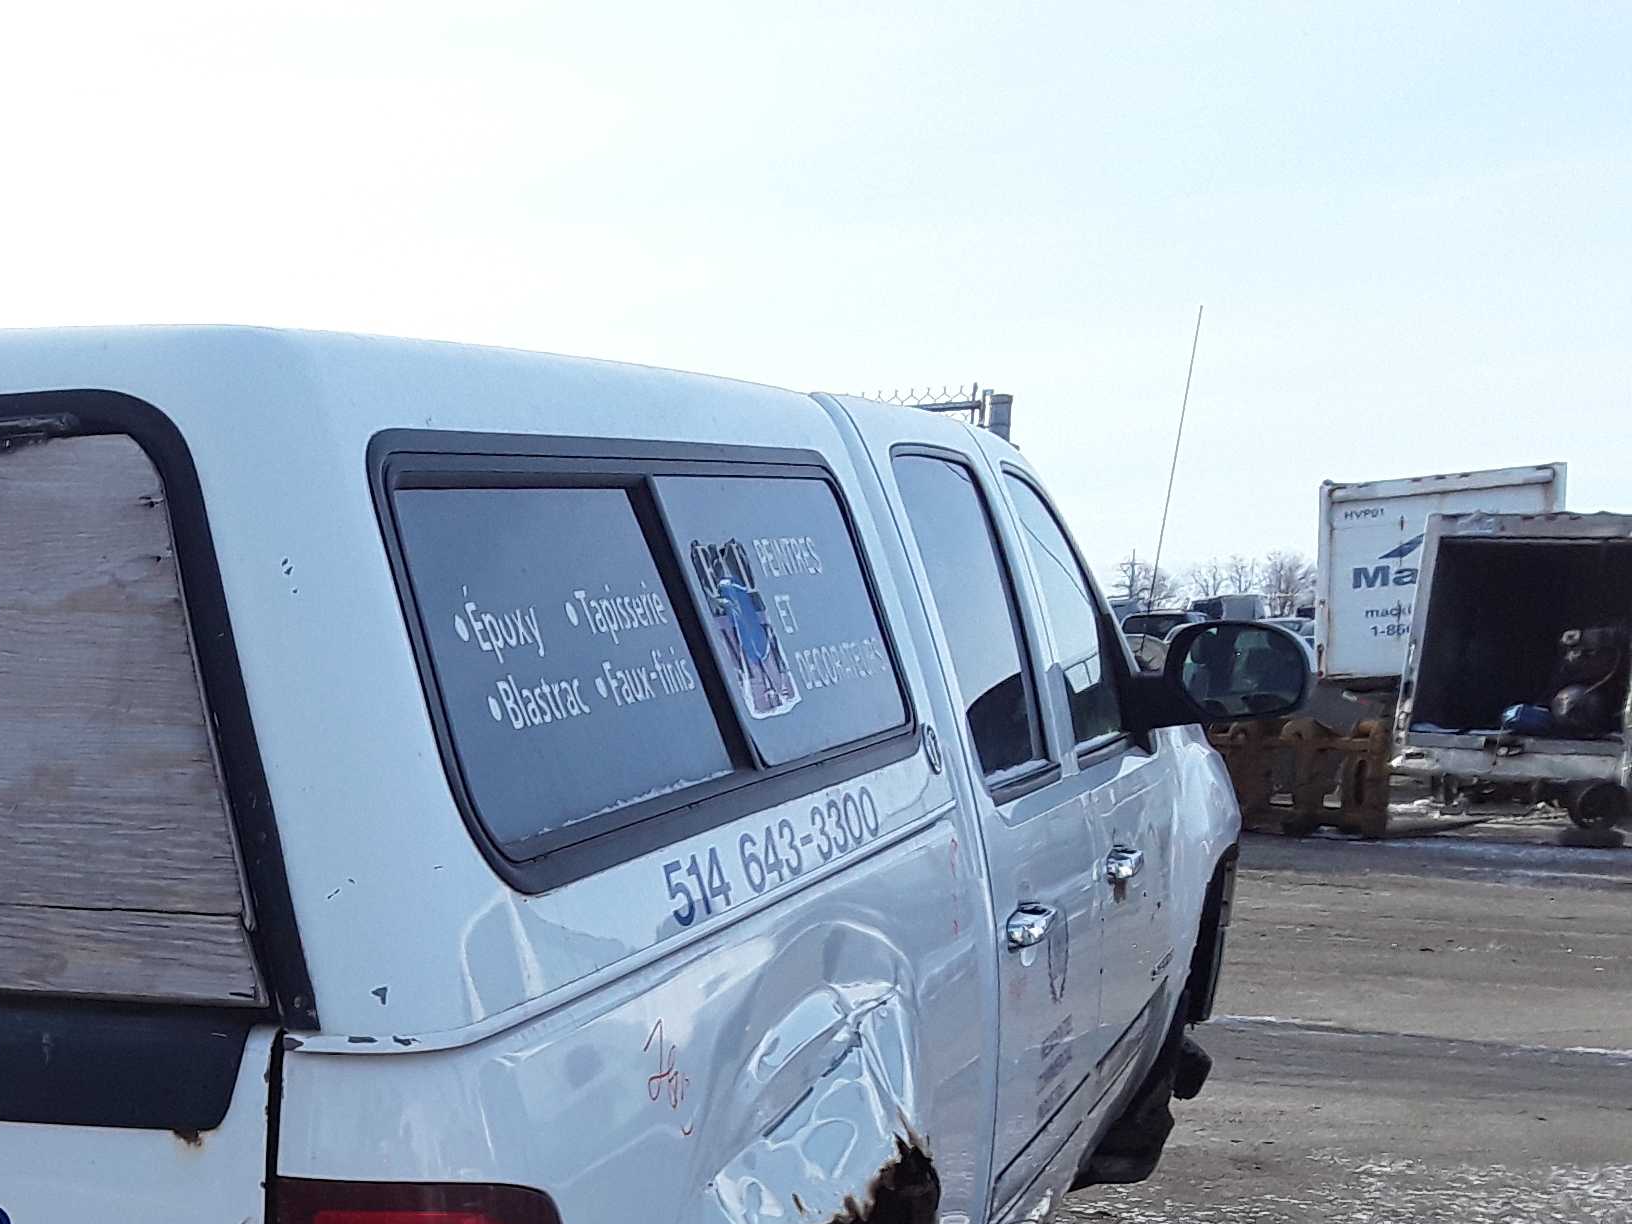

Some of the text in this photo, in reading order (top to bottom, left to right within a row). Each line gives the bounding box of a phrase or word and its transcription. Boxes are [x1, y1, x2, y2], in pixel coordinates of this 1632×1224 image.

[753, 537, 822, 577] PEINTRES
[574, 581, 668, 644] Tapisserie
[774, 595, 798, 633] ET
[496, 647, 695, 729] Blastrac Faux-finis
[663, 847, 732, 926] 514
[739, 787, 879, 893] 643-3300
